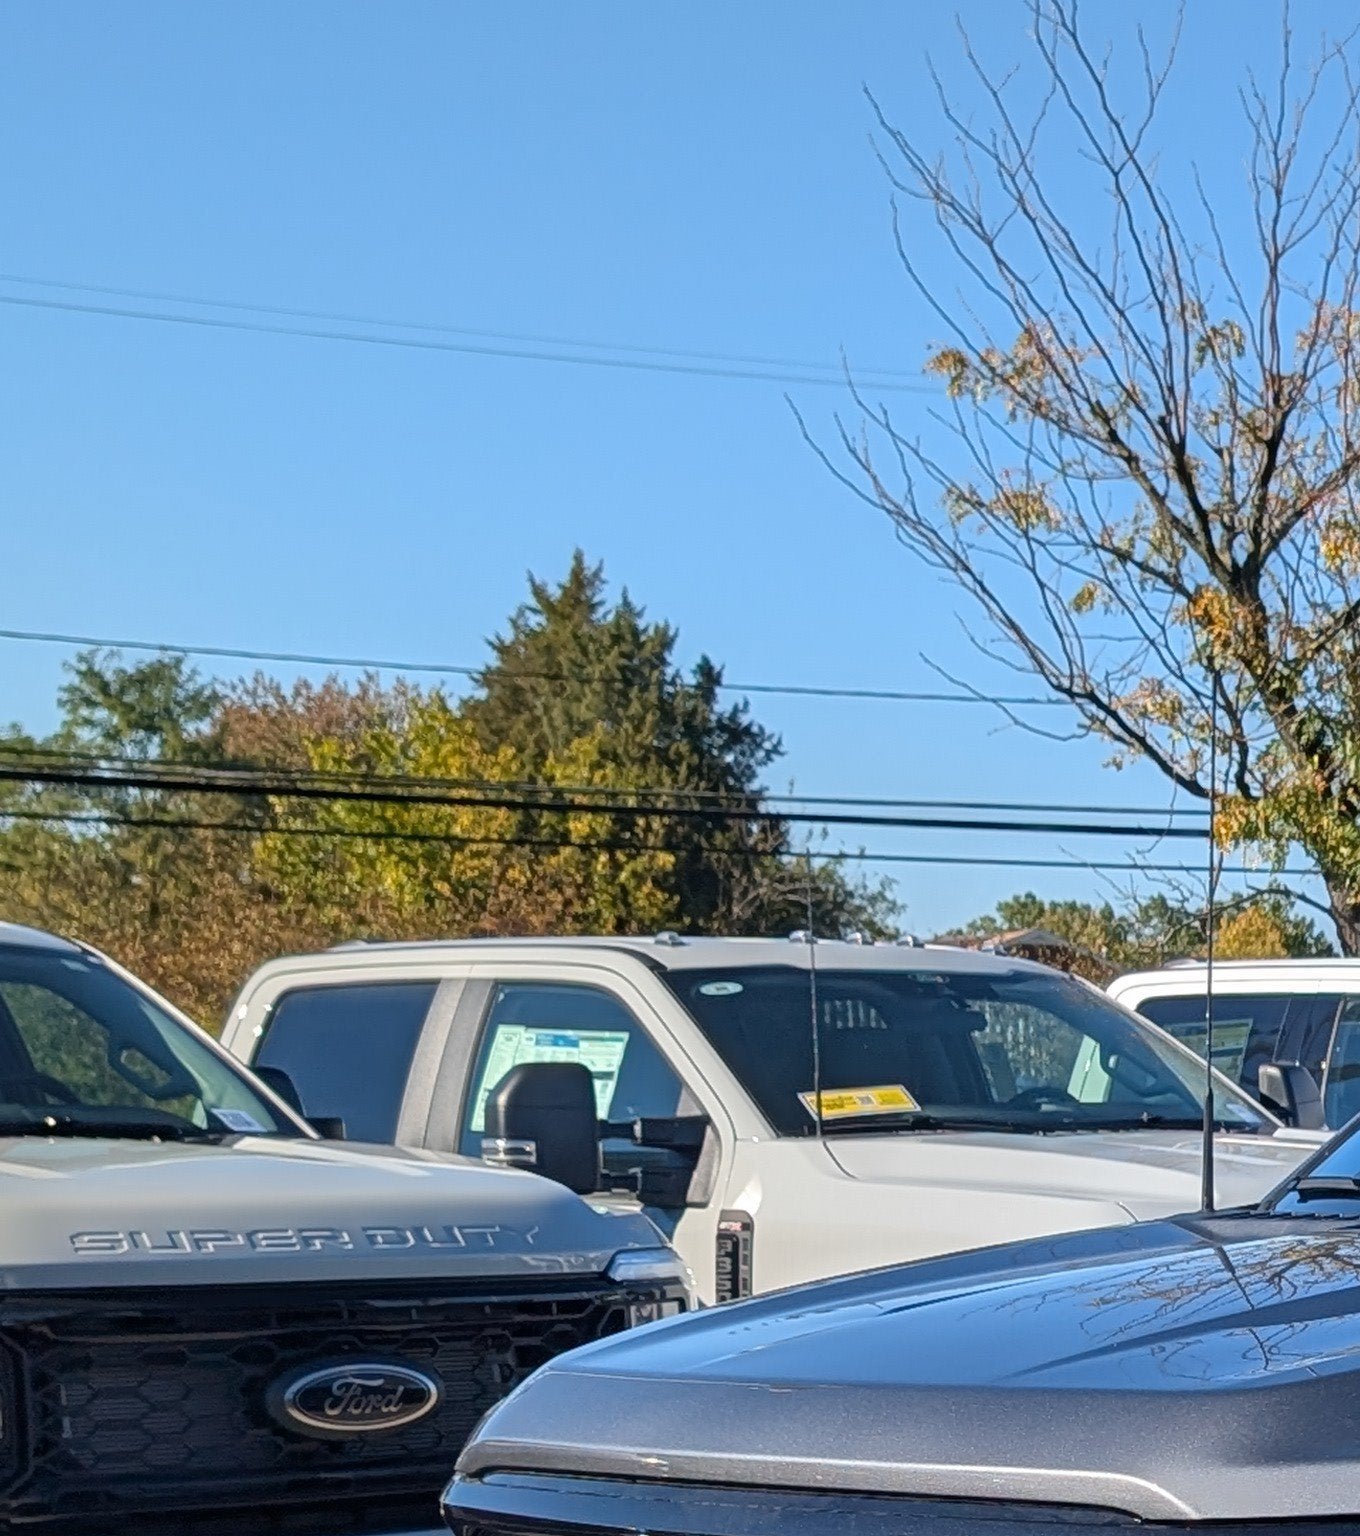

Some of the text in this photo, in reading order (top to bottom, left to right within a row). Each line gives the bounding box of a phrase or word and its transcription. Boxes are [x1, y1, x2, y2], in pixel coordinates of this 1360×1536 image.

[69, 1222, 540, 1256] SUPER DUTY
[324, 1372, 403, 1416] Ford
